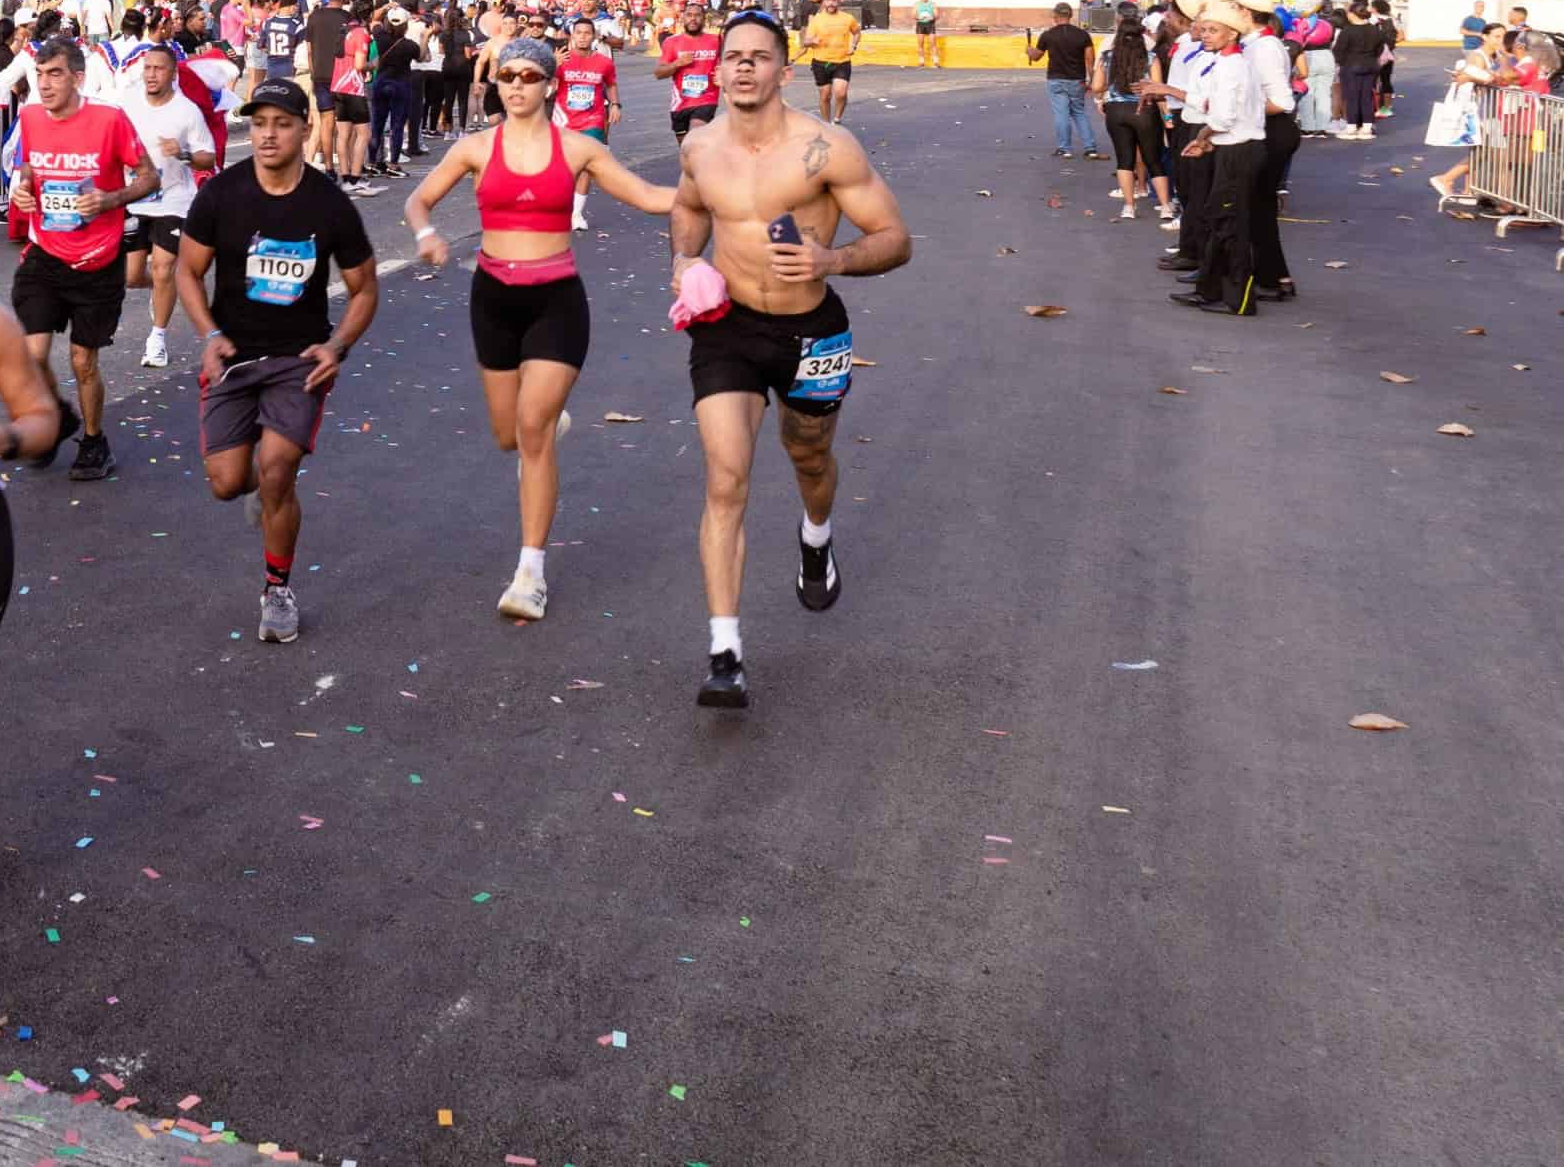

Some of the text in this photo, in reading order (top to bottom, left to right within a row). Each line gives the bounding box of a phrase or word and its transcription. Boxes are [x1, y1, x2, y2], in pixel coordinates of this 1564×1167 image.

[268, 32, 290, 56] 12
[259, 258, 305, 278] 1100
[806, 351, 852, 376] 3247
